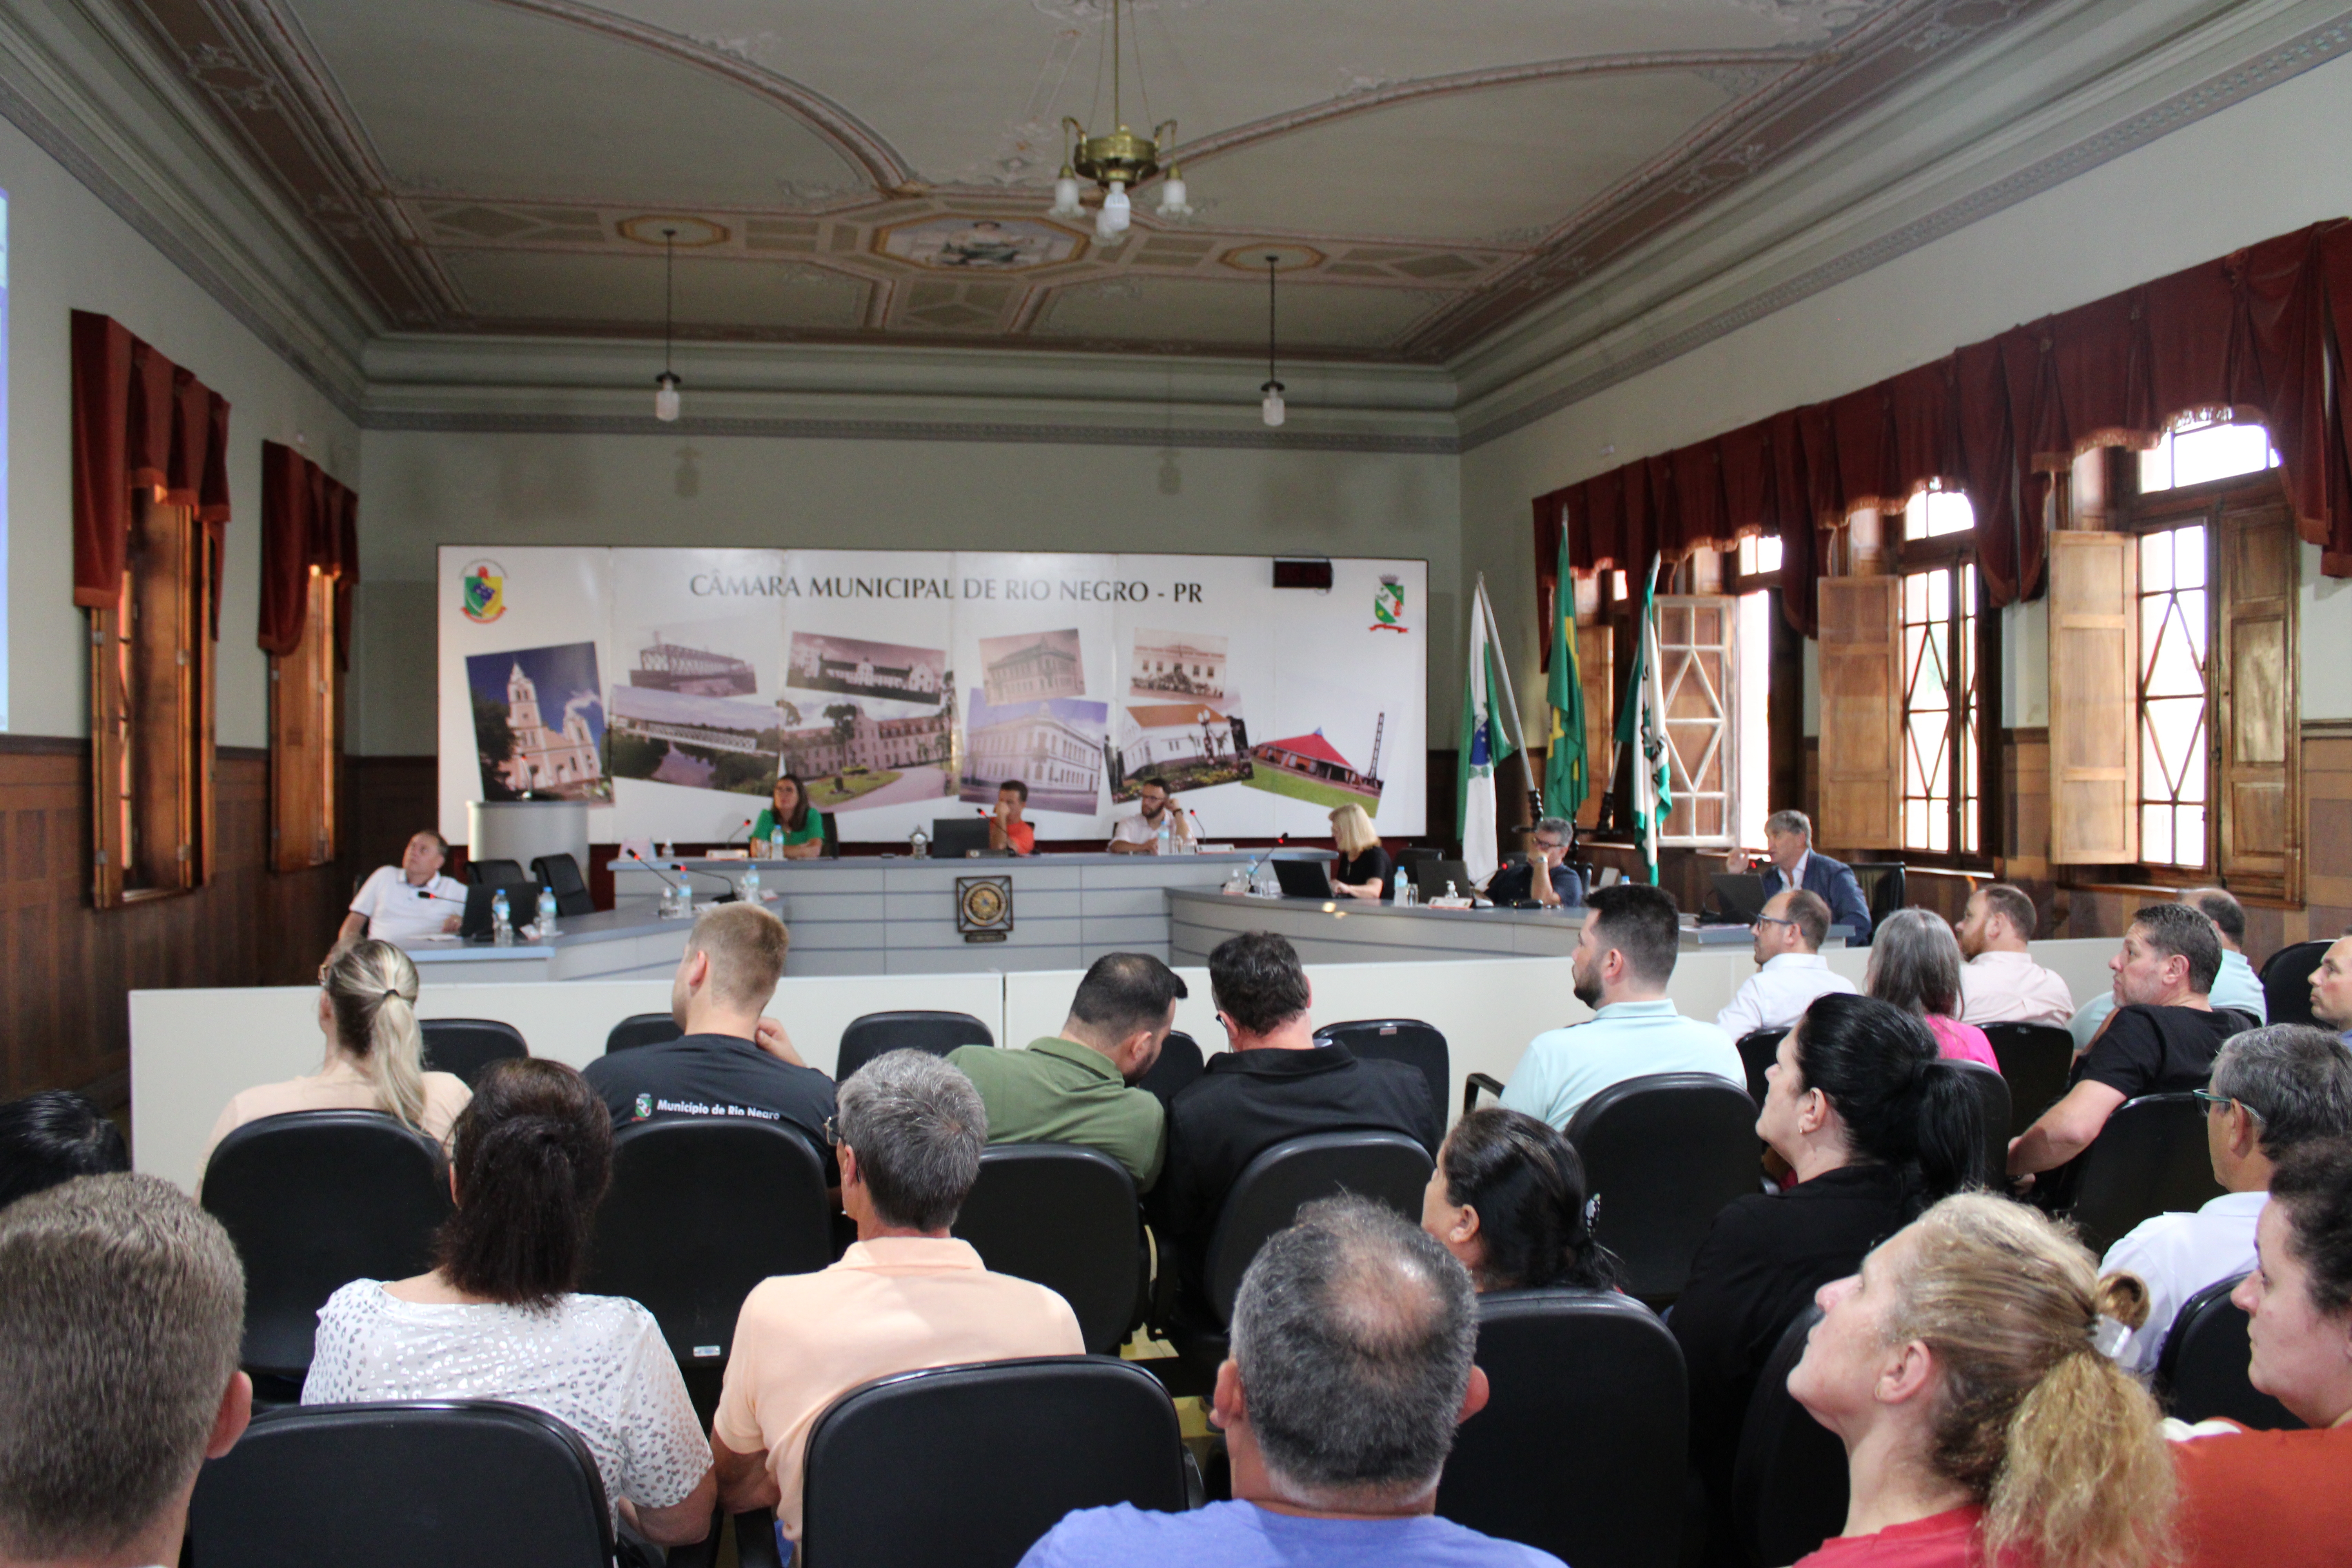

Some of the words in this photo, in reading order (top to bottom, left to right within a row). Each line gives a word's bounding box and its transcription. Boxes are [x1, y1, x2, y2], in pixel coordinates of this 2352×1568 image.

[689, 568, 801, 597] CÂMARA
[809, 577, 954, 599] MUNICIPAL
[964, 578, 996, 599] DE
[1005, 579, 1051, 601] RIO
[1060, 580, 1149, 602] NEGRO
[1174, 582, 1202, 603] PR
[711, 1103, 726, 1115] de
[728, 1105, 745, 1116] Rio
